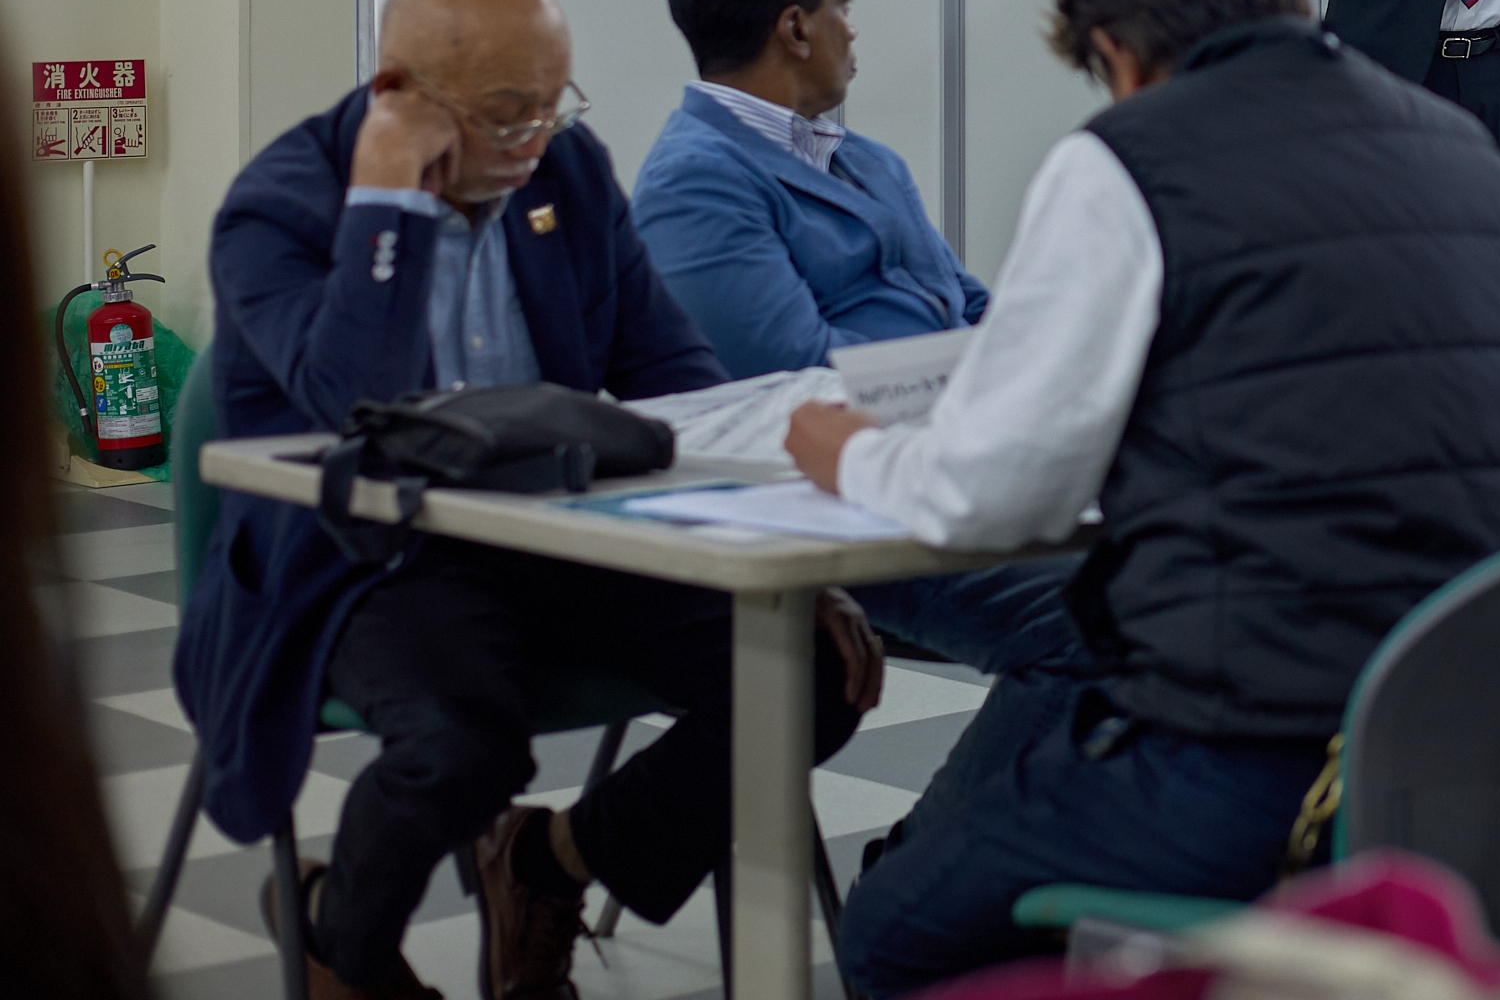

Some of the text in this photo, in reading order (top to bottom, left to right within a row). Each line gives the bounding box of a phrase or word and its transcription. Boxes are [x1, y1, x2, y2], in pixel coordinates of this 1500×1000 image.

[43, 61, 136, 89] 消火器
[56, 88, 123, 100] FIRE EXTINGUISHER
[73, 110, 79, 120] 2
[112, 108, 118, 118] 3
